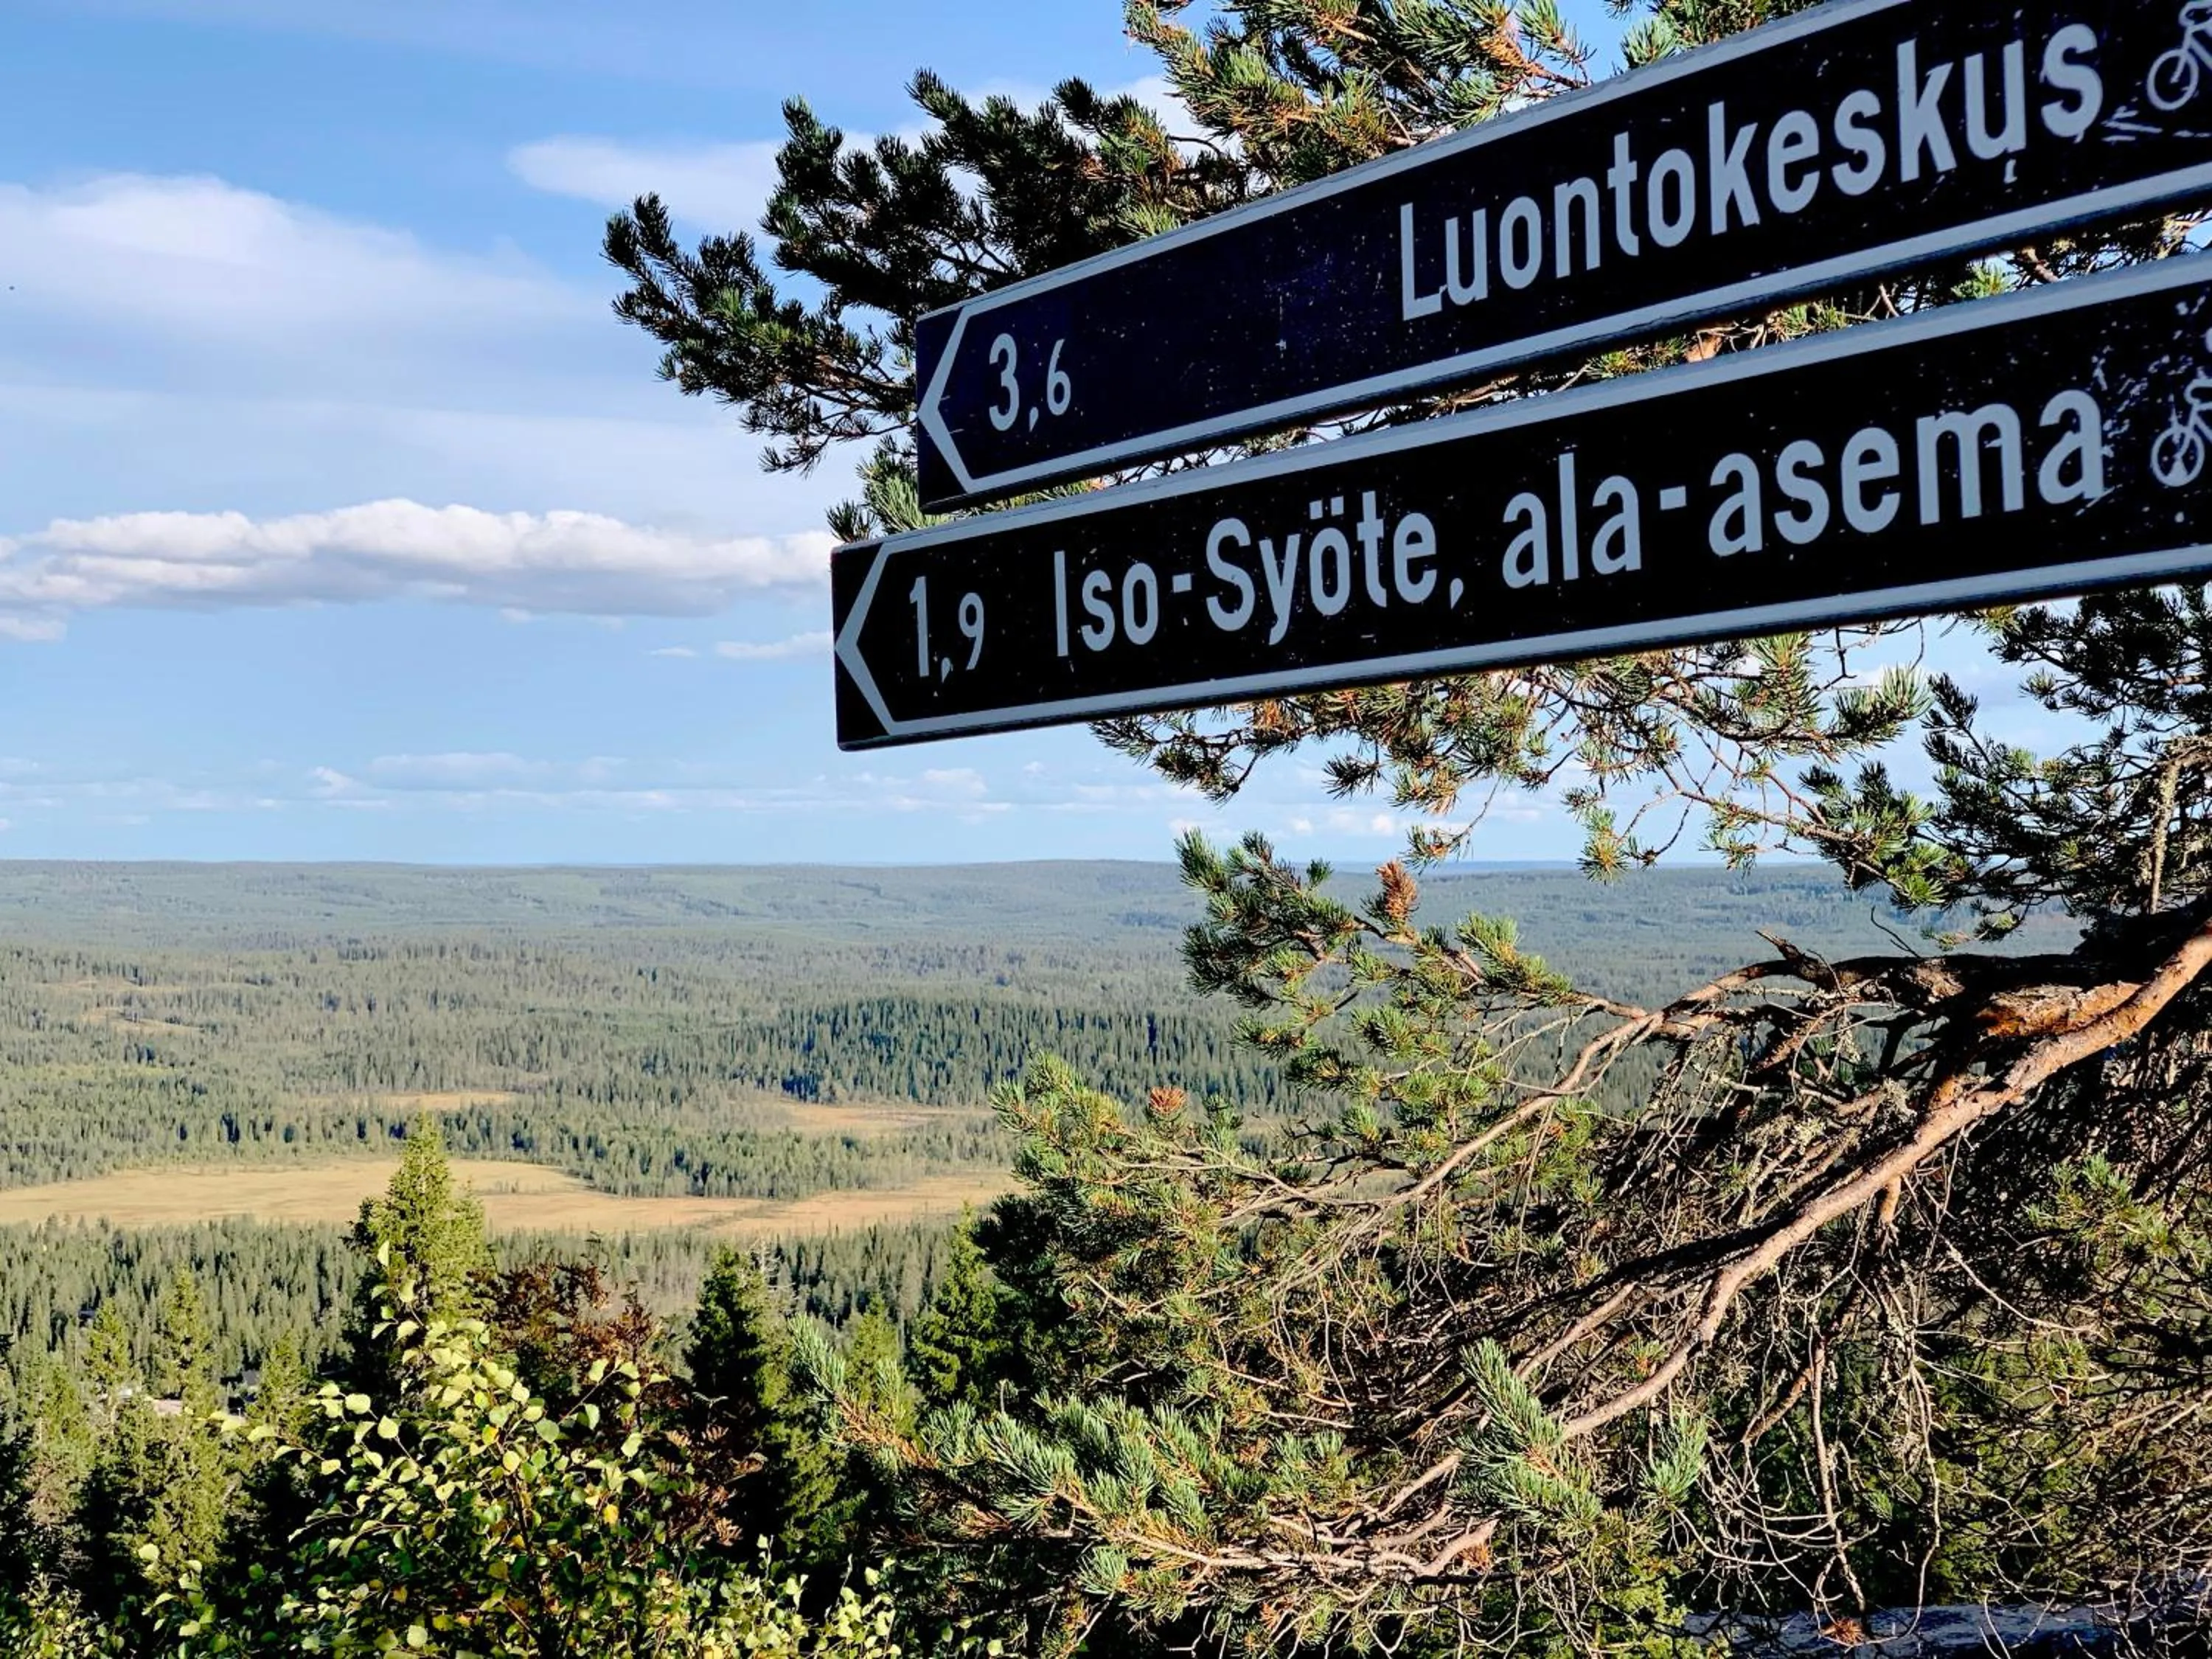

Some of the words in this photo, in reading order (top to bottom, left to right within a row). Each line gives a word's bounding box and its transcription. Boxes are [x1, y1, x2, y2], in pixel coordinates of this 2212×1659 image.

[989, 333, 1071, 432] 3,6
[1400, 23, 2103, 321] Luontokeskus
[909, 577, 985, 684] 1,9
[1054, 490, 1464, 657] Iso-Syöte,
[1501, 389, 2106, 589] ala-asema
